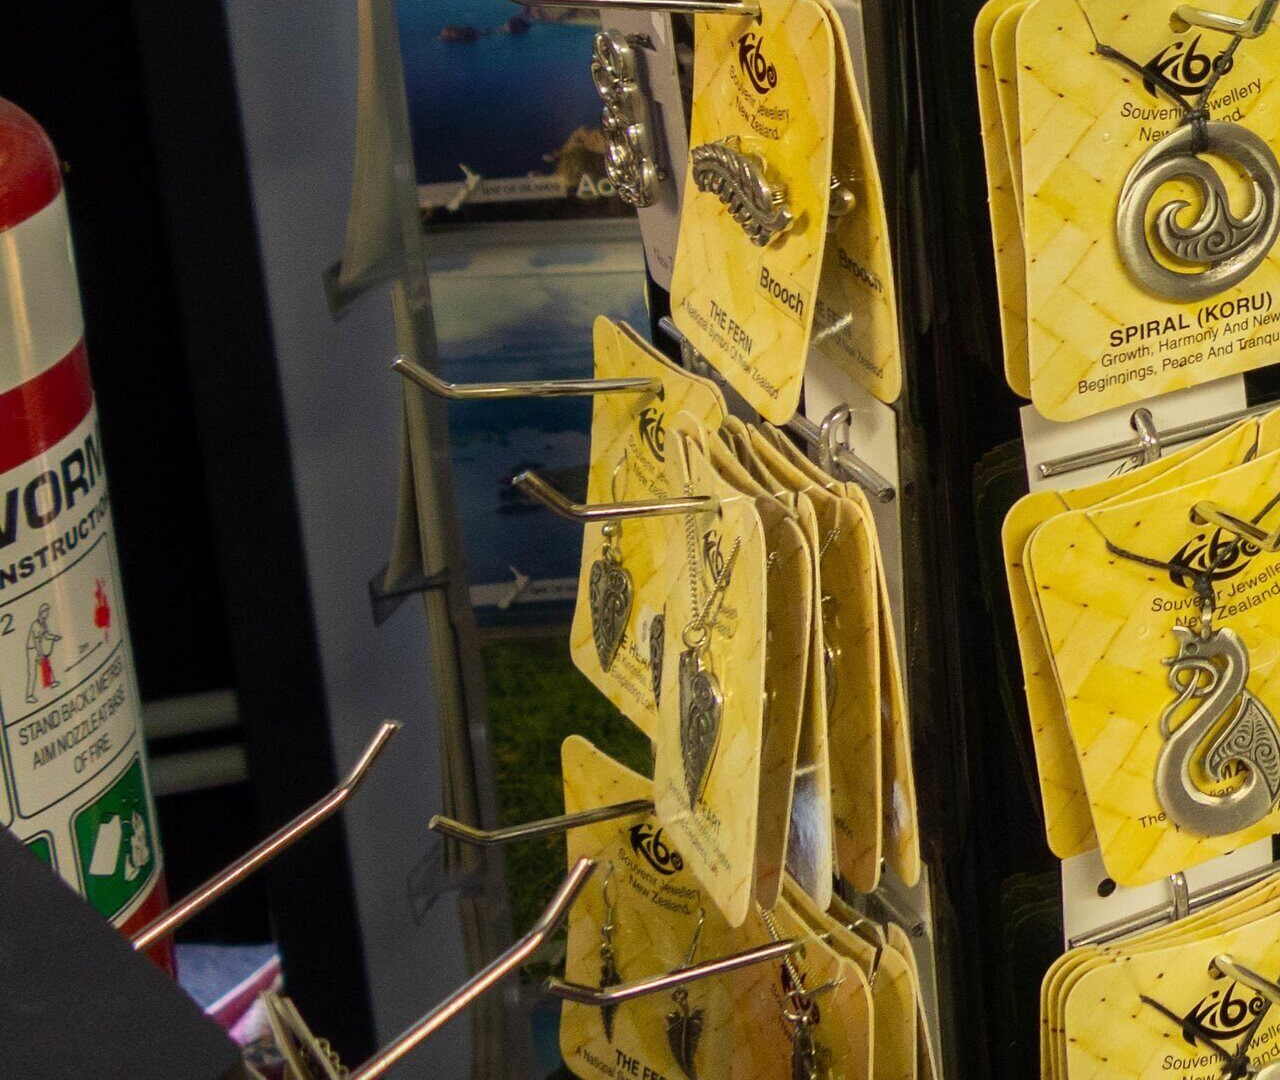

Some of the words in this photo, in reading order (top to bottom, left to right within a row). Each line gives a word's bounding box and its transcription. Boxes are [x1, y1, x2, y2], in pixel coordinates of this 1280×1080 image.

[1121, 101, 1189, 121] Souveni
[1203, 77, 1263, 112] ewellery
[680, 295, 687, 308] A
[686, 300, 709, 332] National
[759, 265, 805, 317] Brooch
[709, 299, 728, 331] THE
[727, 318, 754, 356] FERN
[1110, 313, 1190, 348] SPIRAL
[1197, 290, 1273, 329] (KORU)
[1101, 344, 1155, 369] Growth,
[1158, 325, 1220, 353] Harmony
[1222, 318, 1249, 337] And
[1078, 364, 1158, 395] Beginnings,
[1162, 350, 1204, 371] Peace
[1207, 340, 1234, 360] And
[2, 613, 16, 637] 2
[18, 708, 61, 746] STAND
[60, 688, 92, 723] BACK
[33, 740, 57, 770] AIM
[56, 711, 101, 756] NOZZLE
[74, 749, 88, 774] OF
[88, 732, 112, 764] FIRE
[1138, 811, 1168, 829] The
[575, 1044, 582, 1057] A
[616, 1048, 640, 1078] THE
